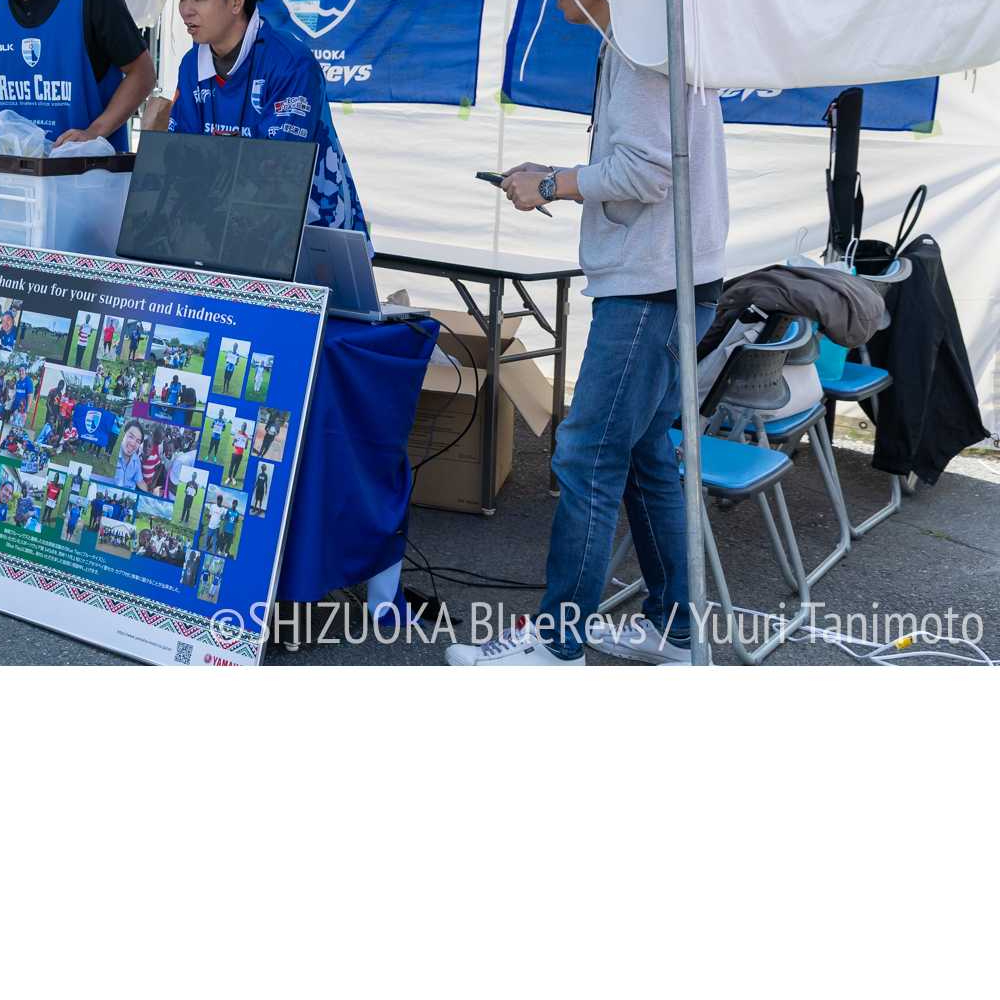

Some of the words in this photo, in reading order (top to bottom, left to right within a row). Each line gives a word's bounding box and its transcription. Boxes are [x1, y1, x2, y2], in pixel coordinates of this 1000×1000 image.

[311, 48, 345, 60] UOKA
[27, 282, 48, 294] you
[50, 283, 69, 298] for
[70, 289, 98, 302] your
[99, 293, 147, 310] support
[148, 302, 174, 315] and
[176, 303, 237, 326] kindness.
